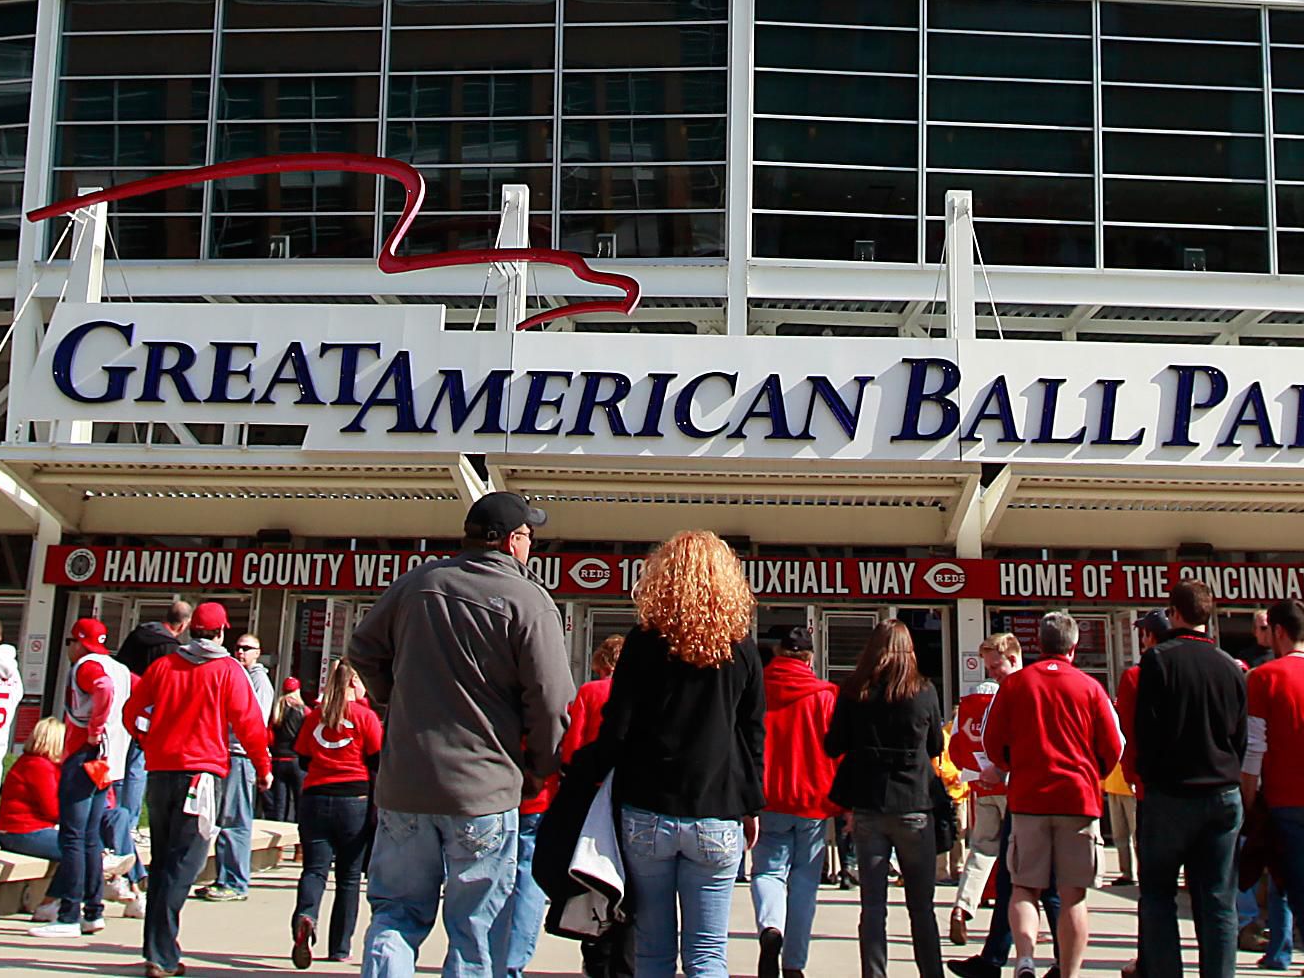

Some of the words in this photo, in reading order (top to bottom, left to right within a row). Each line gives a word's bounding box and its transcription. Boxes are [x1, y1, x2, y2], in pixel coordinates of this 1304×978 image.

[51, 319, 382, 406] GREAT
[339, 349, 875, 442] AMERICAN
[890, 357, 1146, 446] BALL
[102, 549, 233, 585] HAMILTON
[241, 552, 345, 587] COUNTY
[526, 557, 561, 590] OU
[581, 569, 611, 578] REDS
[740, 560, 849, 594] UXHALL
[858, 561, 916, 596] WAY
[935, 572, 966, 584] REDS
[999, 563, 1074, 597] HOME
[1082, 564, 1113, 598] OF
[1121, 565, 1171, 599] THE
